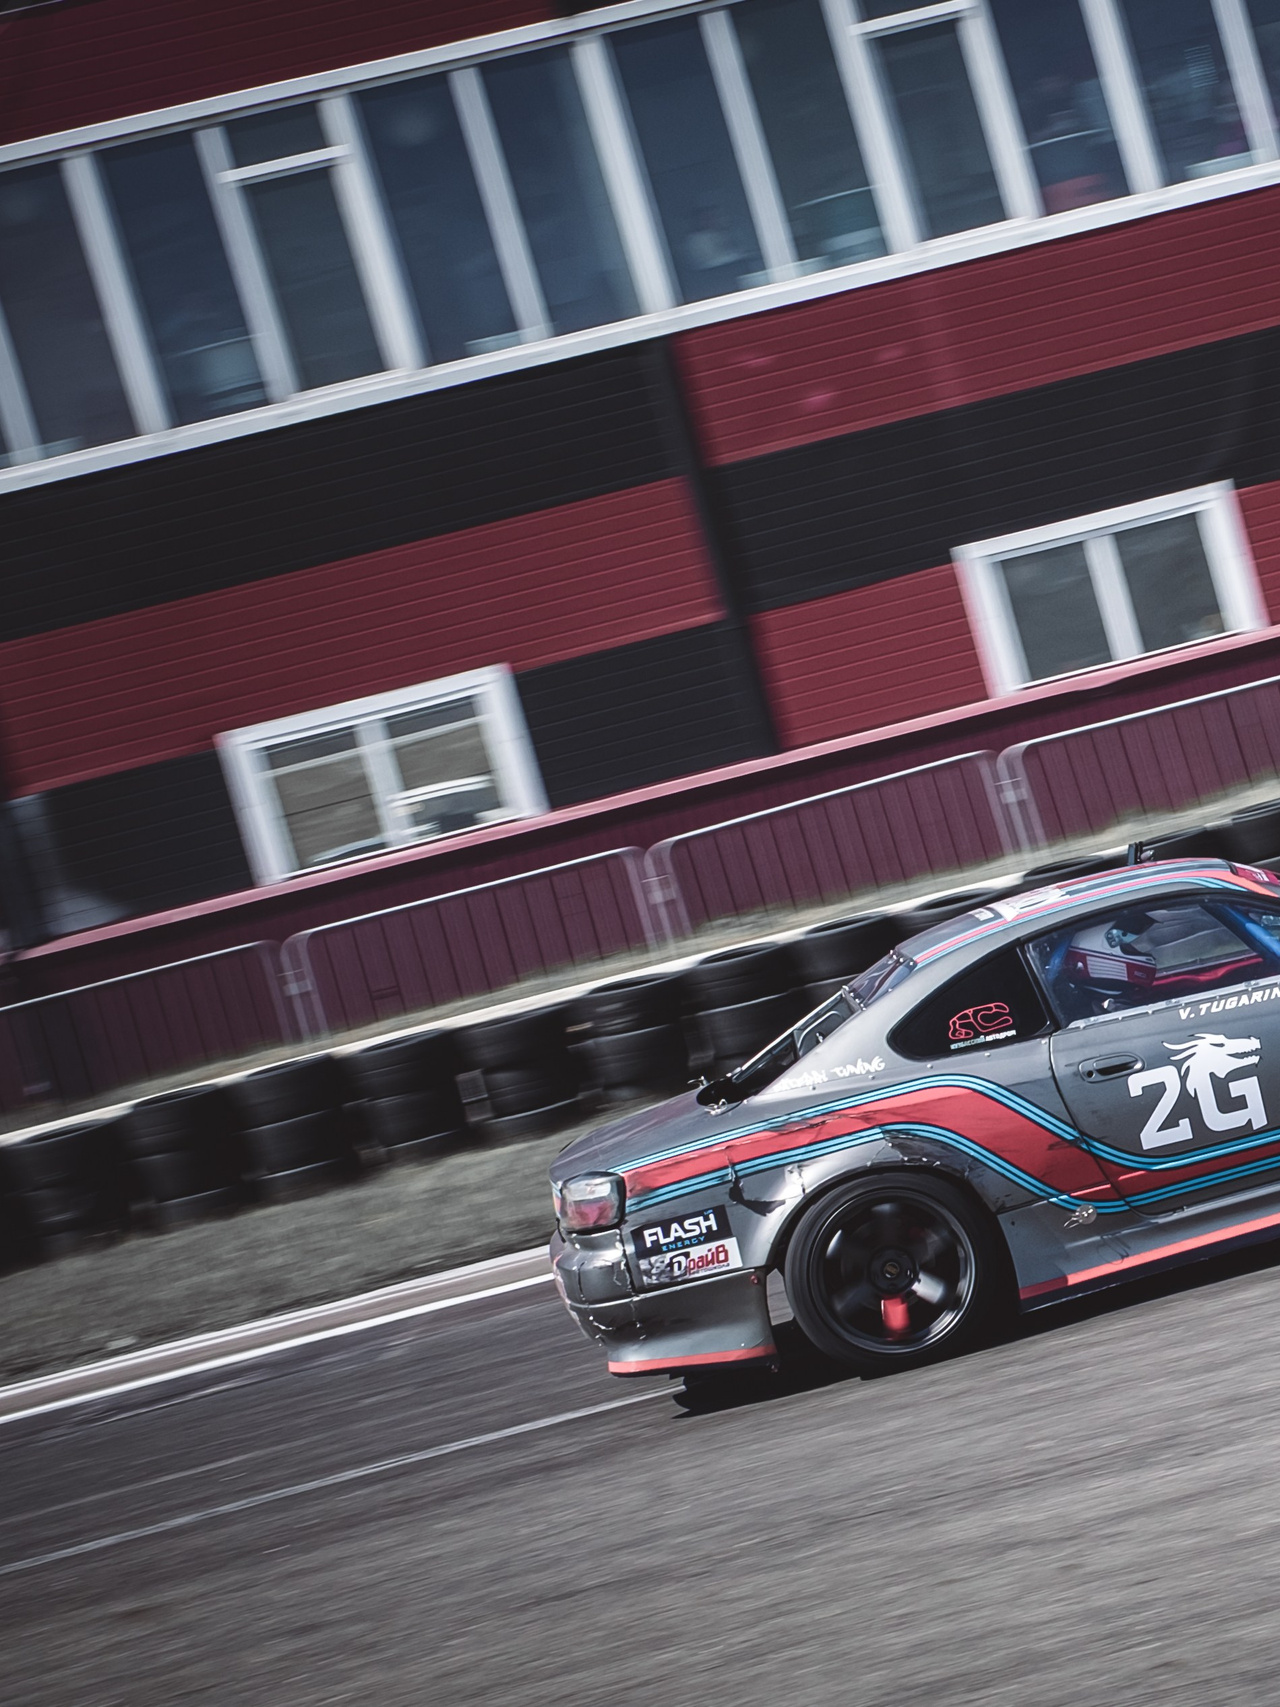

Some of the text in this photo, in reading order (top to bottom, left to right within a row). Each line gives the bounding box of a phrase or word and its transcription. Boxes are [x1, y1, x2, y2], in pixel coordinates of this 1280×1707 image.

[1179, 1007, 1195, 1020] V.
[643, 1213, 718, 1248] FLASH
[661, 1236, 705, 1251] ENERGY
